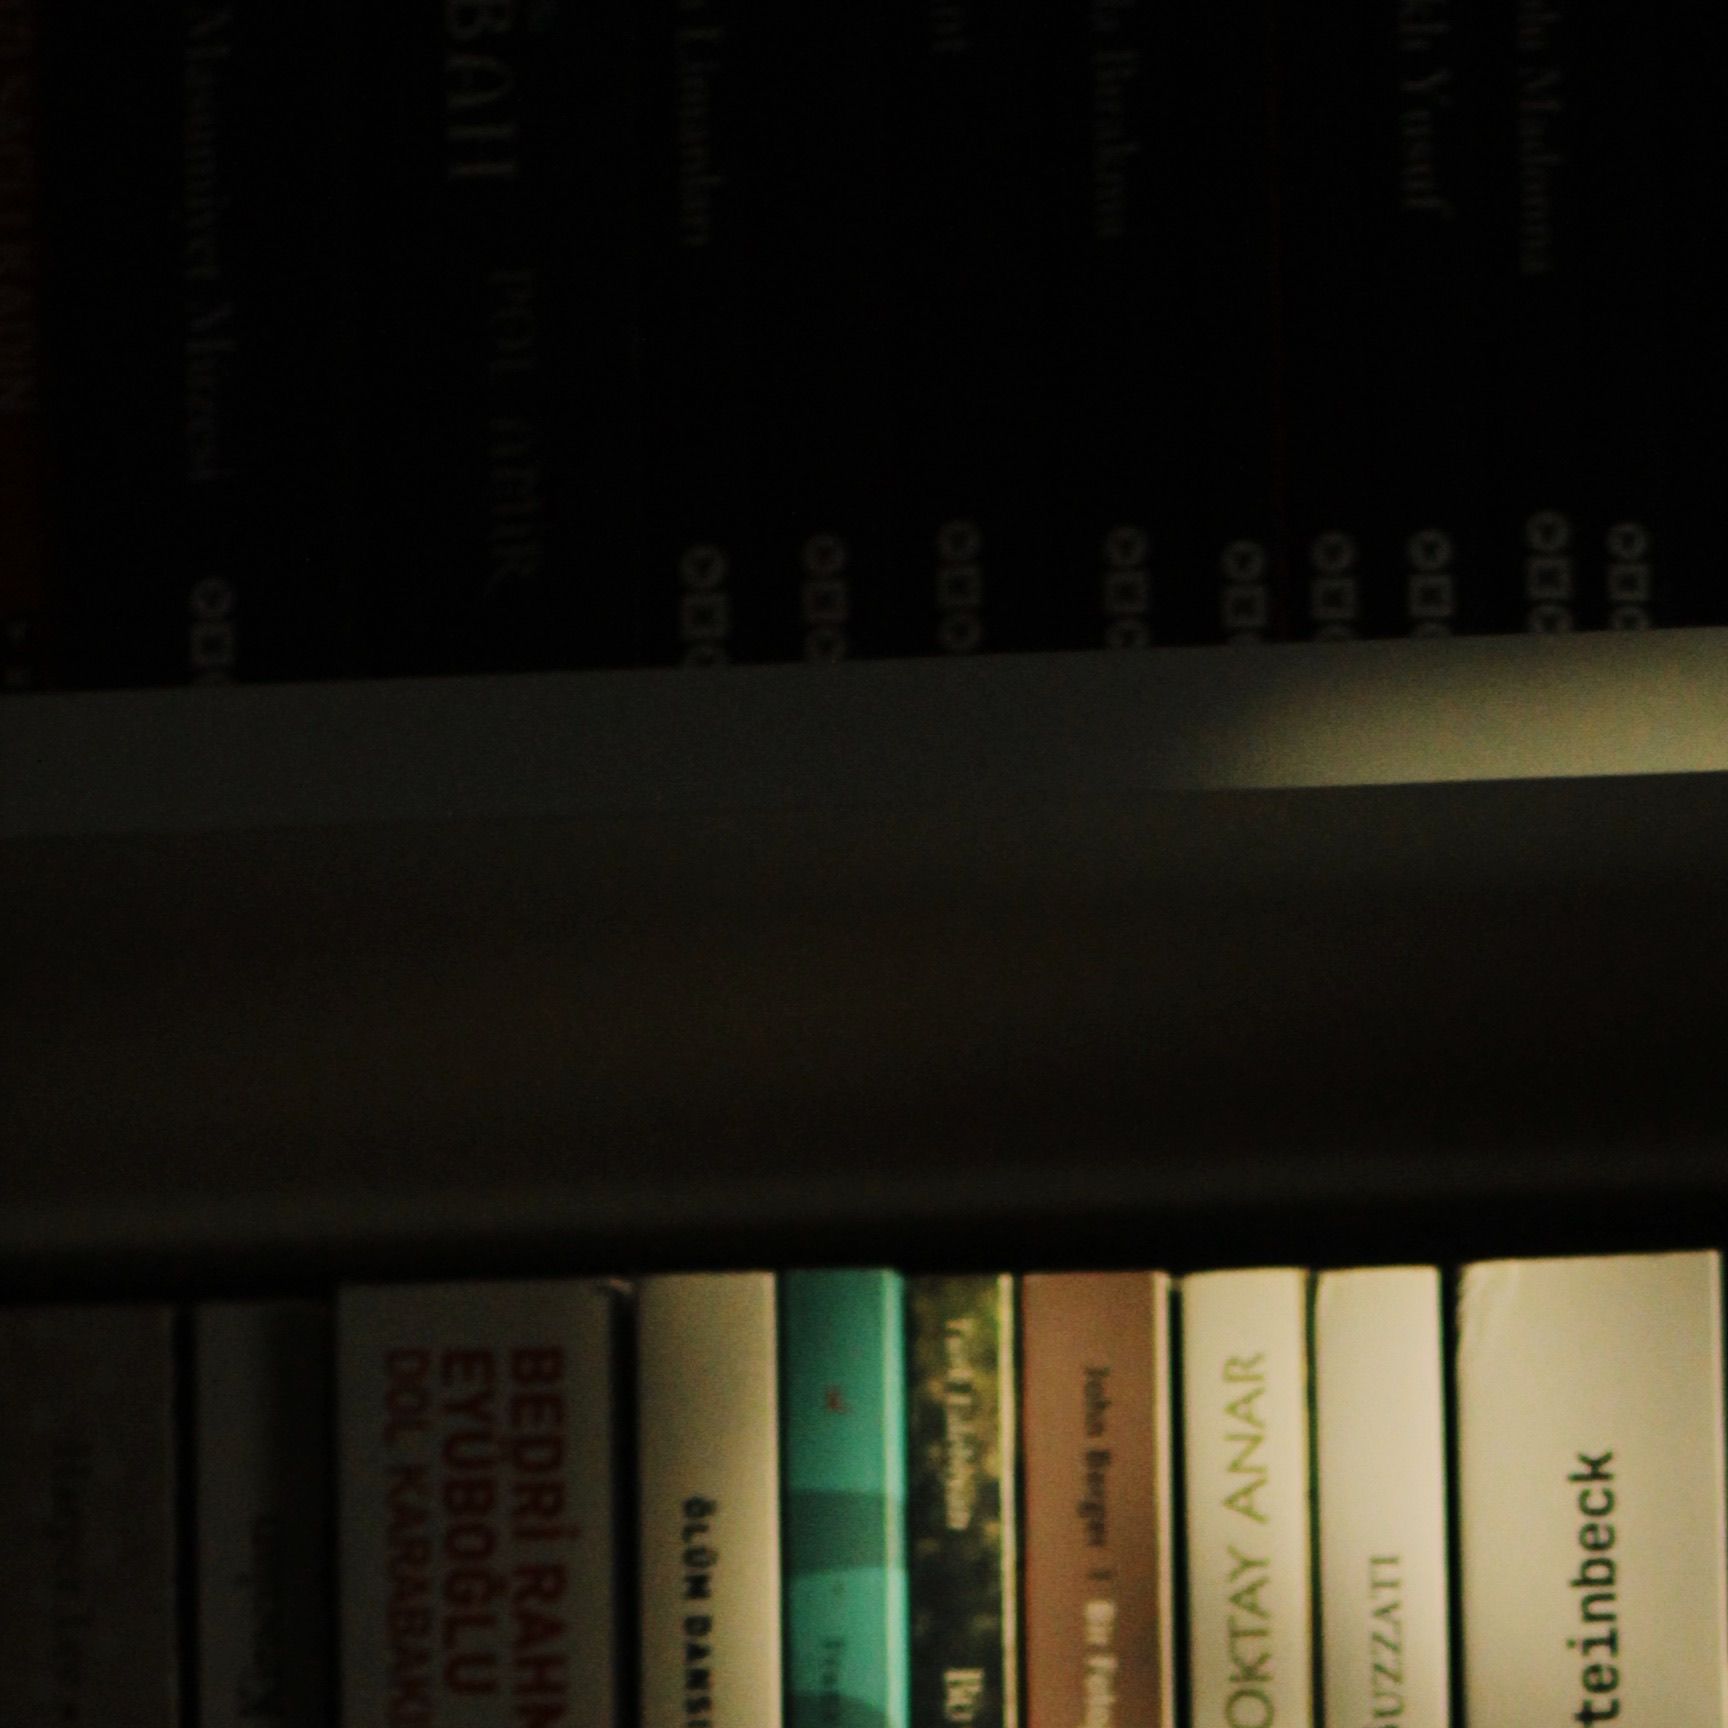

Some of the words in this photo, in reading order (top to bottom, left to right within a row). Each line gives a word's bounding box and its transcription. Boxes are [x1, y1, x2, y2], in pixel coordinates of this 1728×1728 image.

[384, 1349, 430, 1444] DOL
[510, 1347, 580, 1541] BEDRİ
[1221, 1351, 1272, 1525] ANAR
[440, 1349, 508, 1698] EYÜBOĞLU
[683, 1495, 717, 1602] ÖLÜM
